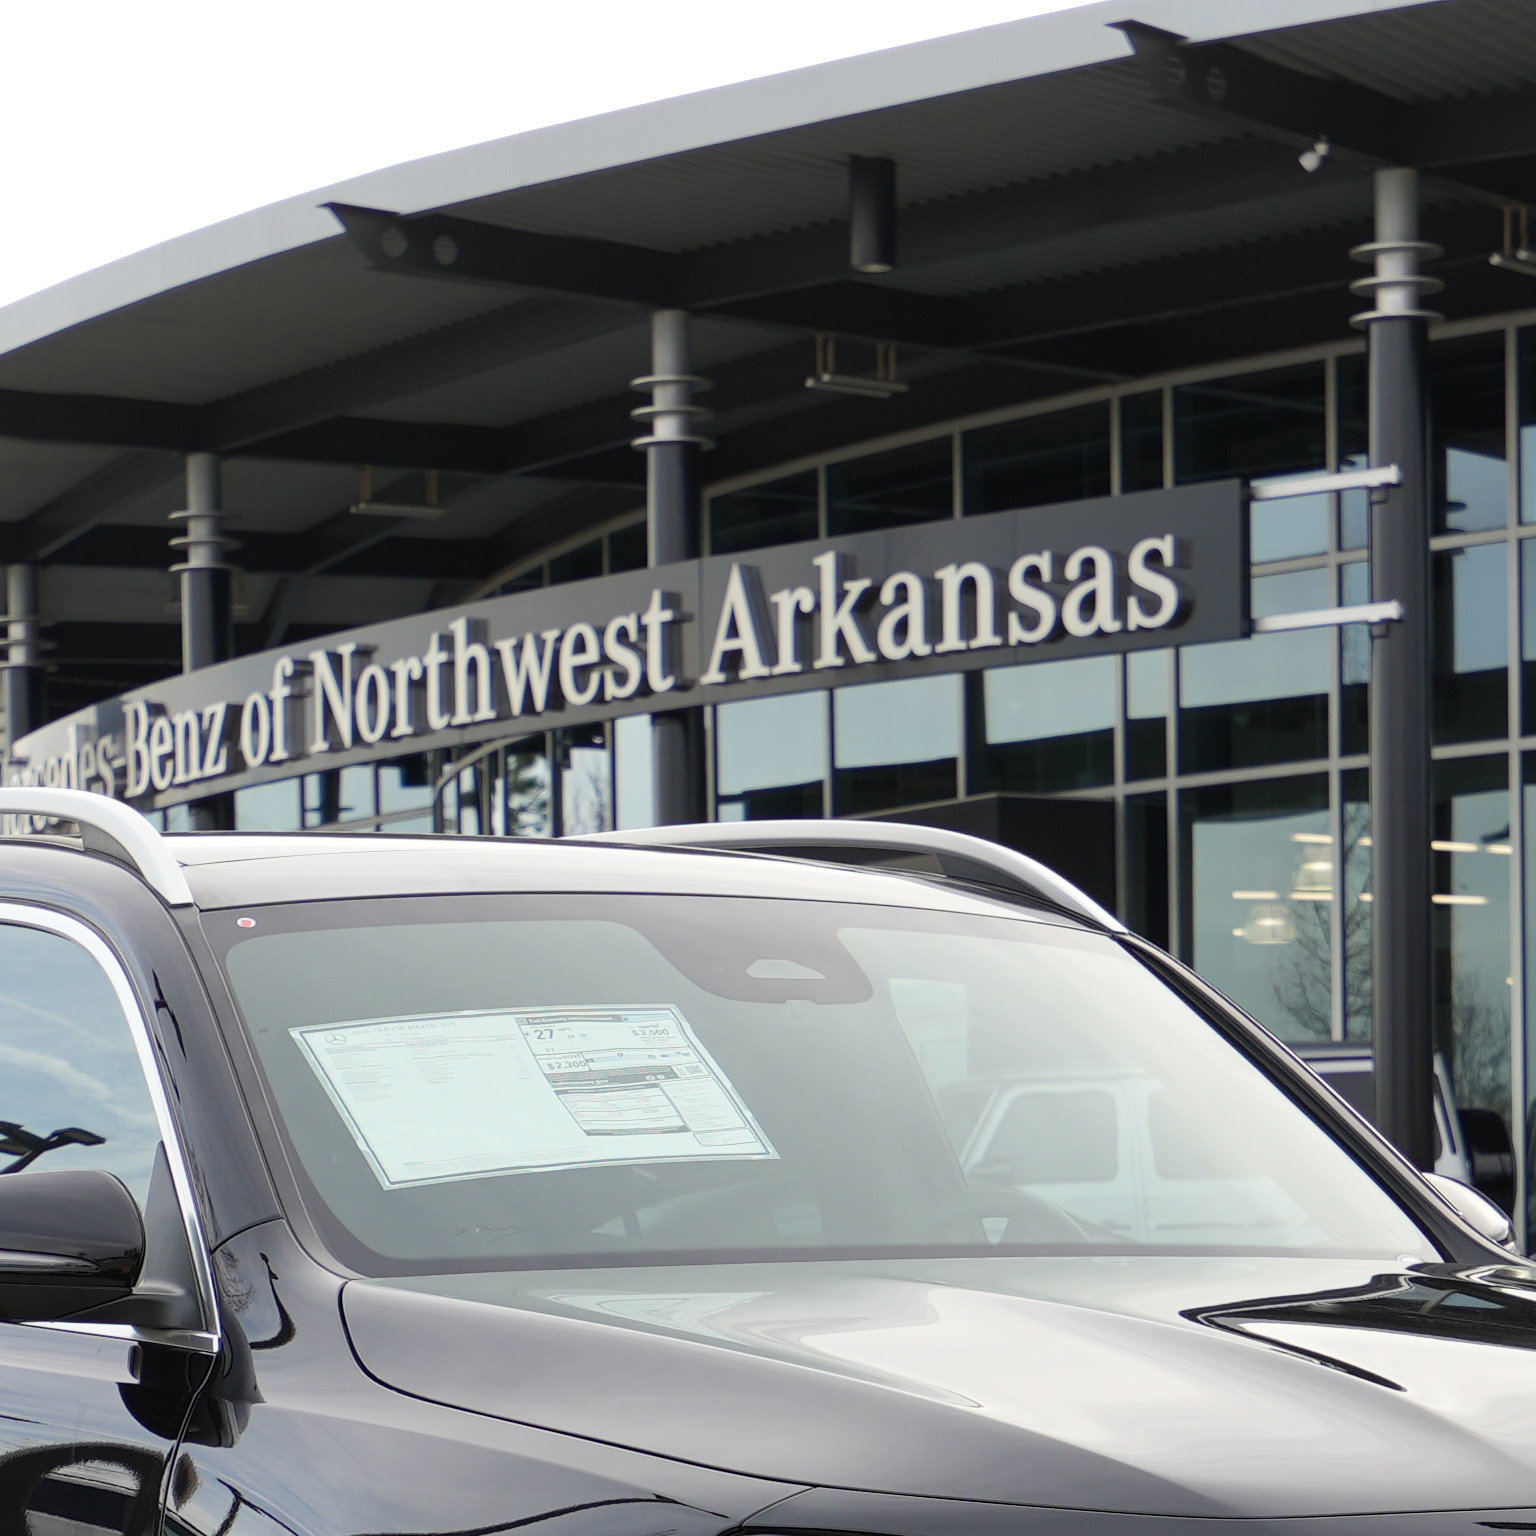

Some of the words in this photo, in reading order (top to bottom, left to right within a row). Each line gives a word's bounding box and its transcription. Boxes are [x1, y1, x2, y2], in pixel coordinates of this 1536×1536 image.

[239, 656, 293, 767] of
[310, 589, 675, 753] Northwest
[700, 535, 1181, 685] Arkansas
[534, 1028, 554, 1040] 27
